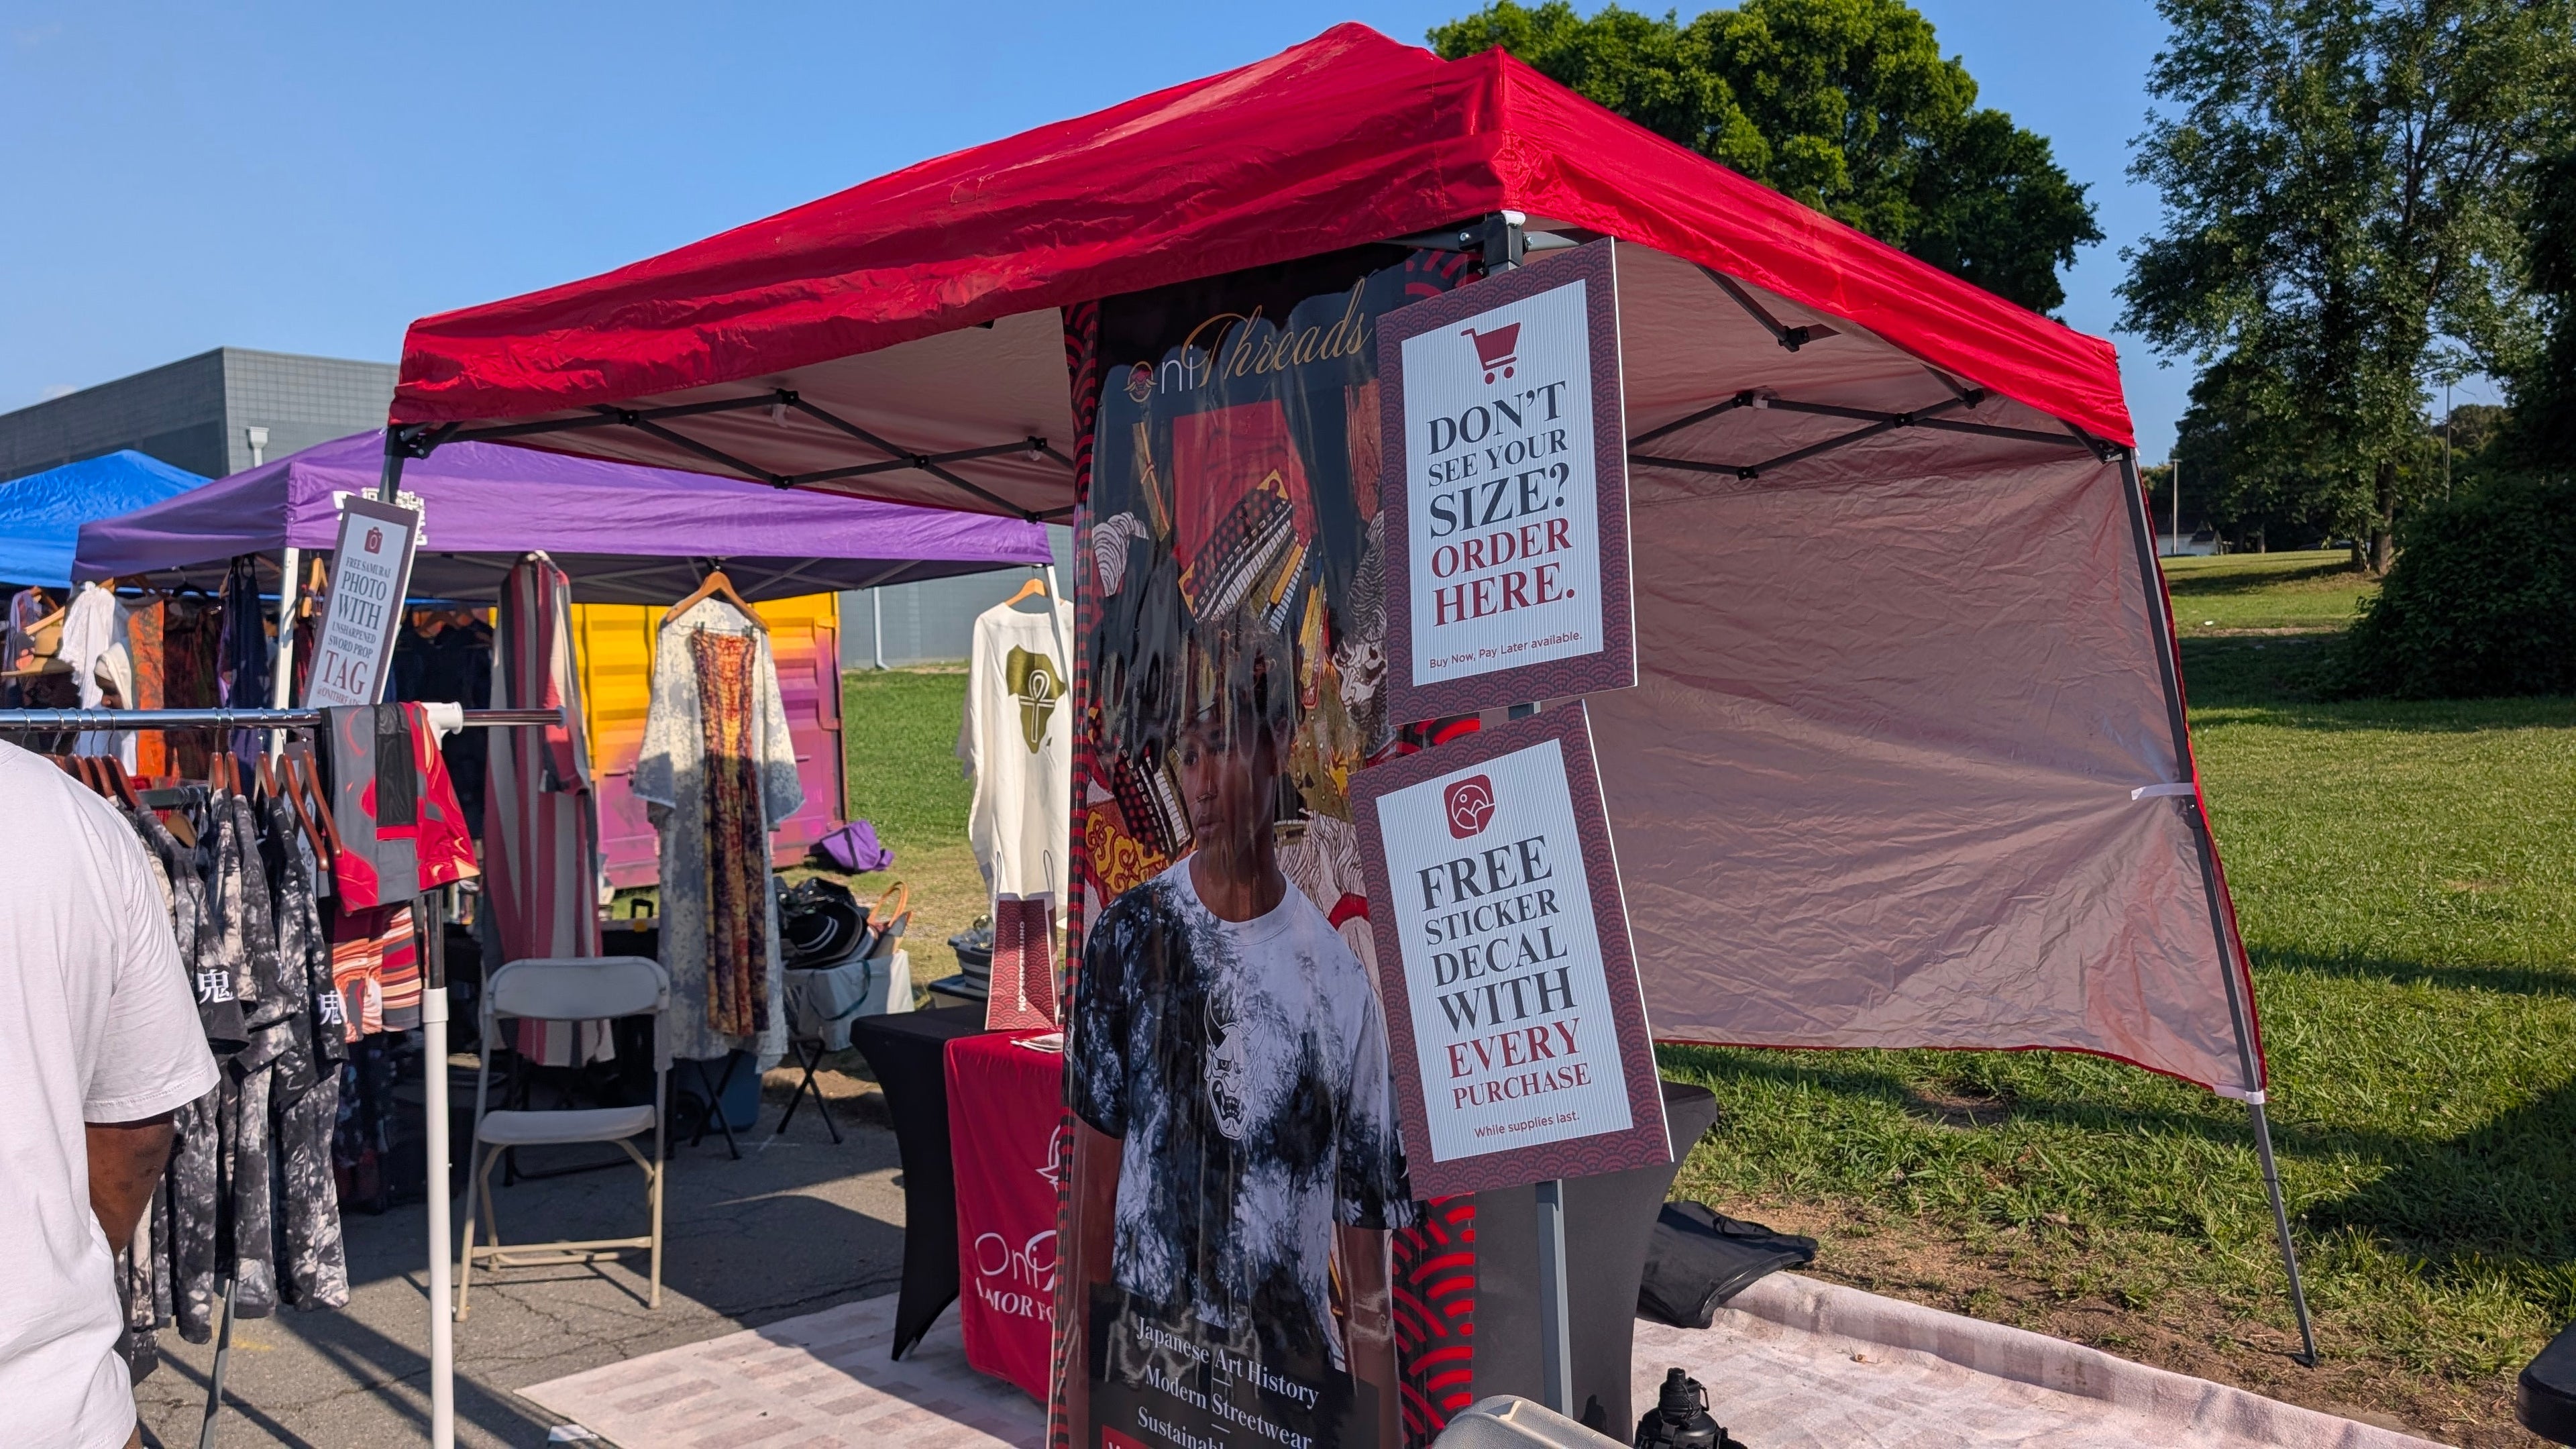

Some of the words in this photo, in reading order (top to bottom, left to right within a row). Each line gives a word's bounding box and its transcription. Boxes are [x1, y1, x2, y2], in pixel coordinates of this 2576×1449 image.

[1123, 344, 1194, 402] Oni
[1182, 278, 1373, 387] Threads
[1427, 380, 1566, 455] DON'T
[1428, 453, 1478, 488] SEE
[1484, 429, 1568, 471] YOUR
[1430, 462, 1569, 540] SIZE?
[345, 557, 361, 570] FREE
[1432, 517, 1572, 578] ORDER
[338, 593, 383, 631] WITH
[341, 571, 387, 602] PHOTO
[1433, 562, 1574, 627] HERE.
[328, 635, 354, 653] SWORD
[353, 643, 374, 659] PROP
[332, 621, 377, 645] UNSHARPENED
[1430, 657, 1448, 669] Buy
[1451, 651, 1476, 664] Now,
[1479, 646, 1497, 659] Pay
[1501, 641, 1528, 655] Later
[1530, 631, 1582, 649] available.
[322, 649, 368, 695] TAG
[1415, 835, 1553, 912] FREE
[1424, 888, 1560, 947] STICKER
[1430, 925, 1568, 987] DECAL
[197, 969, 234, 1004] 鬼
[1436, 966, 1578, 1034] WITH
[1444, 1017, 1580, 1079] EVERY
[1451, 1063, 1592, 1110] PURCHASE
[1474, 1122, 1505, 1138] While
[1507, 1114, 1554, 1134] supplies
[1556, 1110, 1580, 1124] last.
[1136, 1316, 1210, 1364] Japanese
[1214, 1348, 1243, 1378] Art
[1248, 1359, 1320, 1409] History
[1145, 1364, 1208, 1409] Modern
[1212, 1392, 1312, 1449] Streetwear
